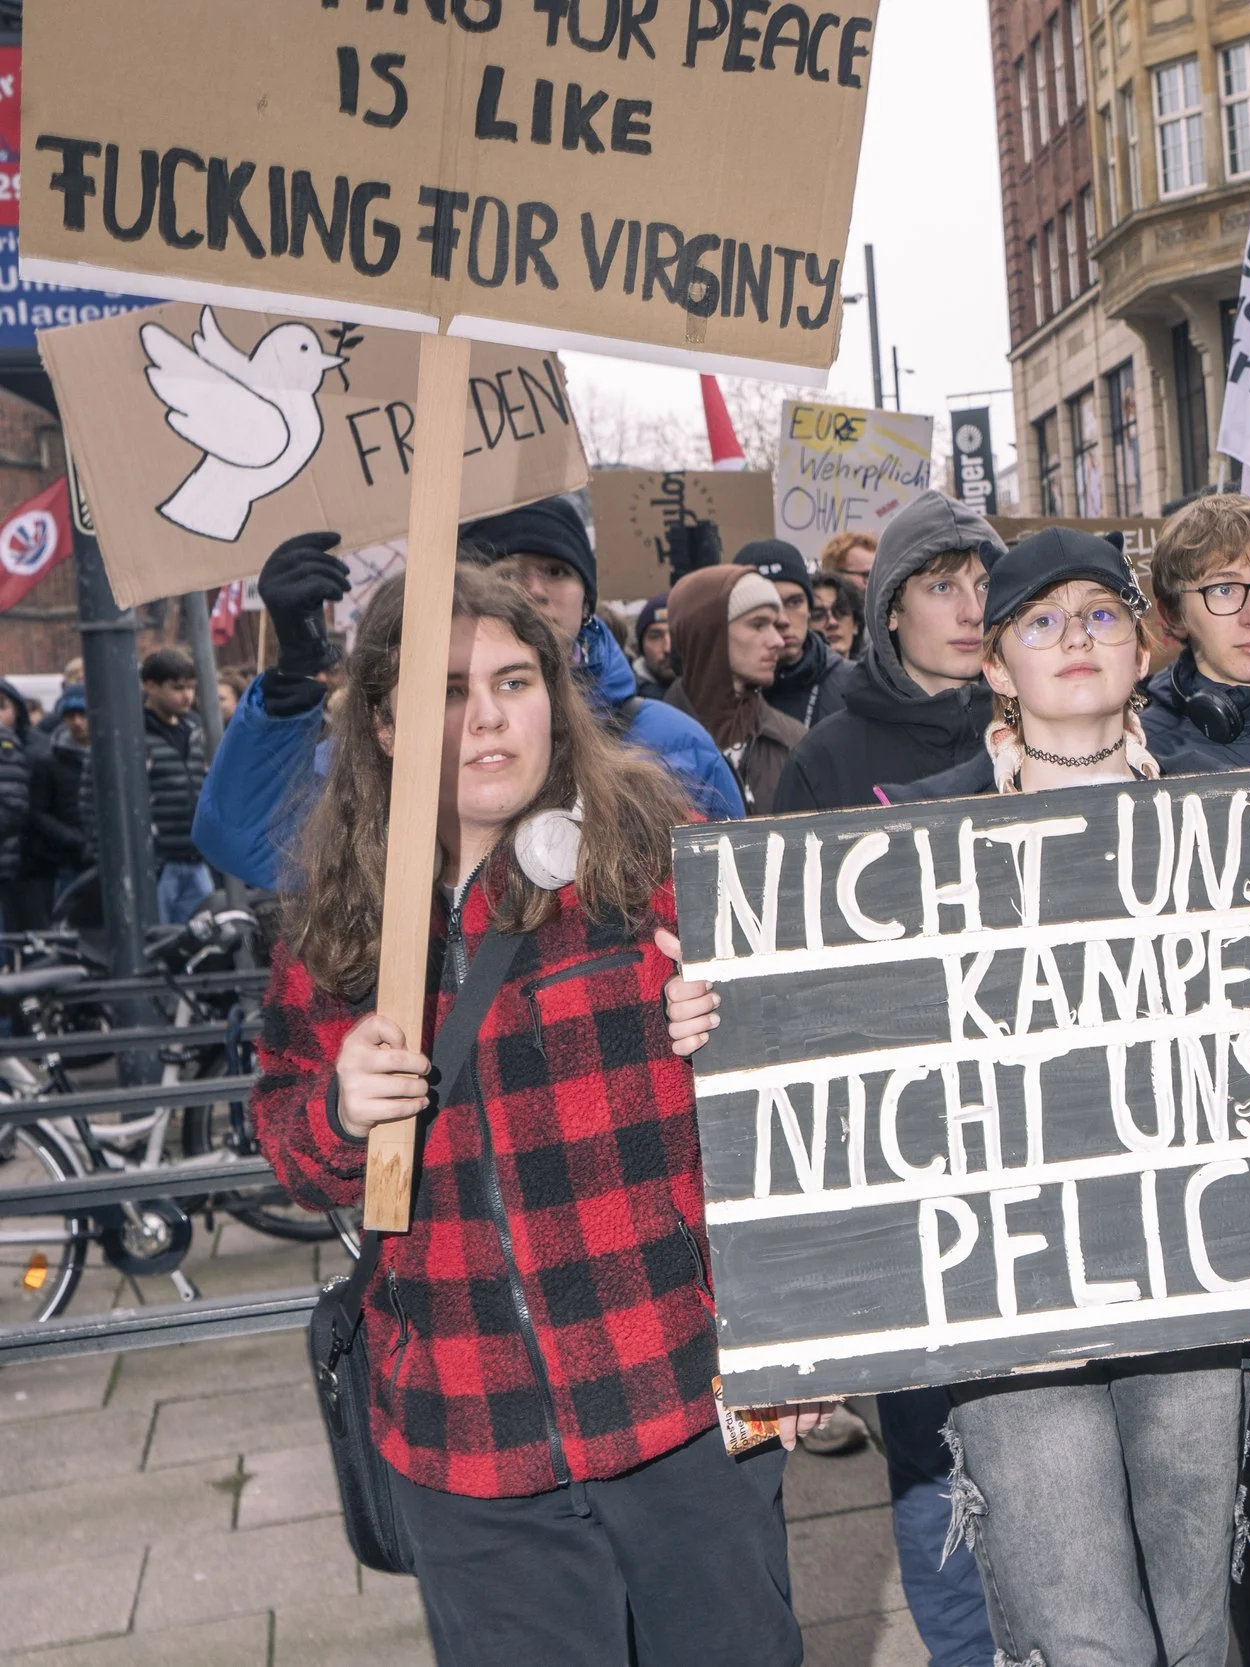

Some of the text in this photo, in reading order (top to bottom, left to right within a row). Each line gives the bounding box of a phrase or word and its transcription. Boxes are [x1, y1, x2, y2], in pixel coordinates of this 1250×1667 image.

[336, 45, 653, 156] IS LIKE
[682, 0, 873, 88] PEACE
[35, 133, 843, 331] FUCKING FOR VIRGINTY
[345, 358, 569, 487] FRDEN
[789, 406, 867, 443] EURE
[714, 816, 1088, 960] NICHT
[754, 1046, 1069, 1198] NICHT
